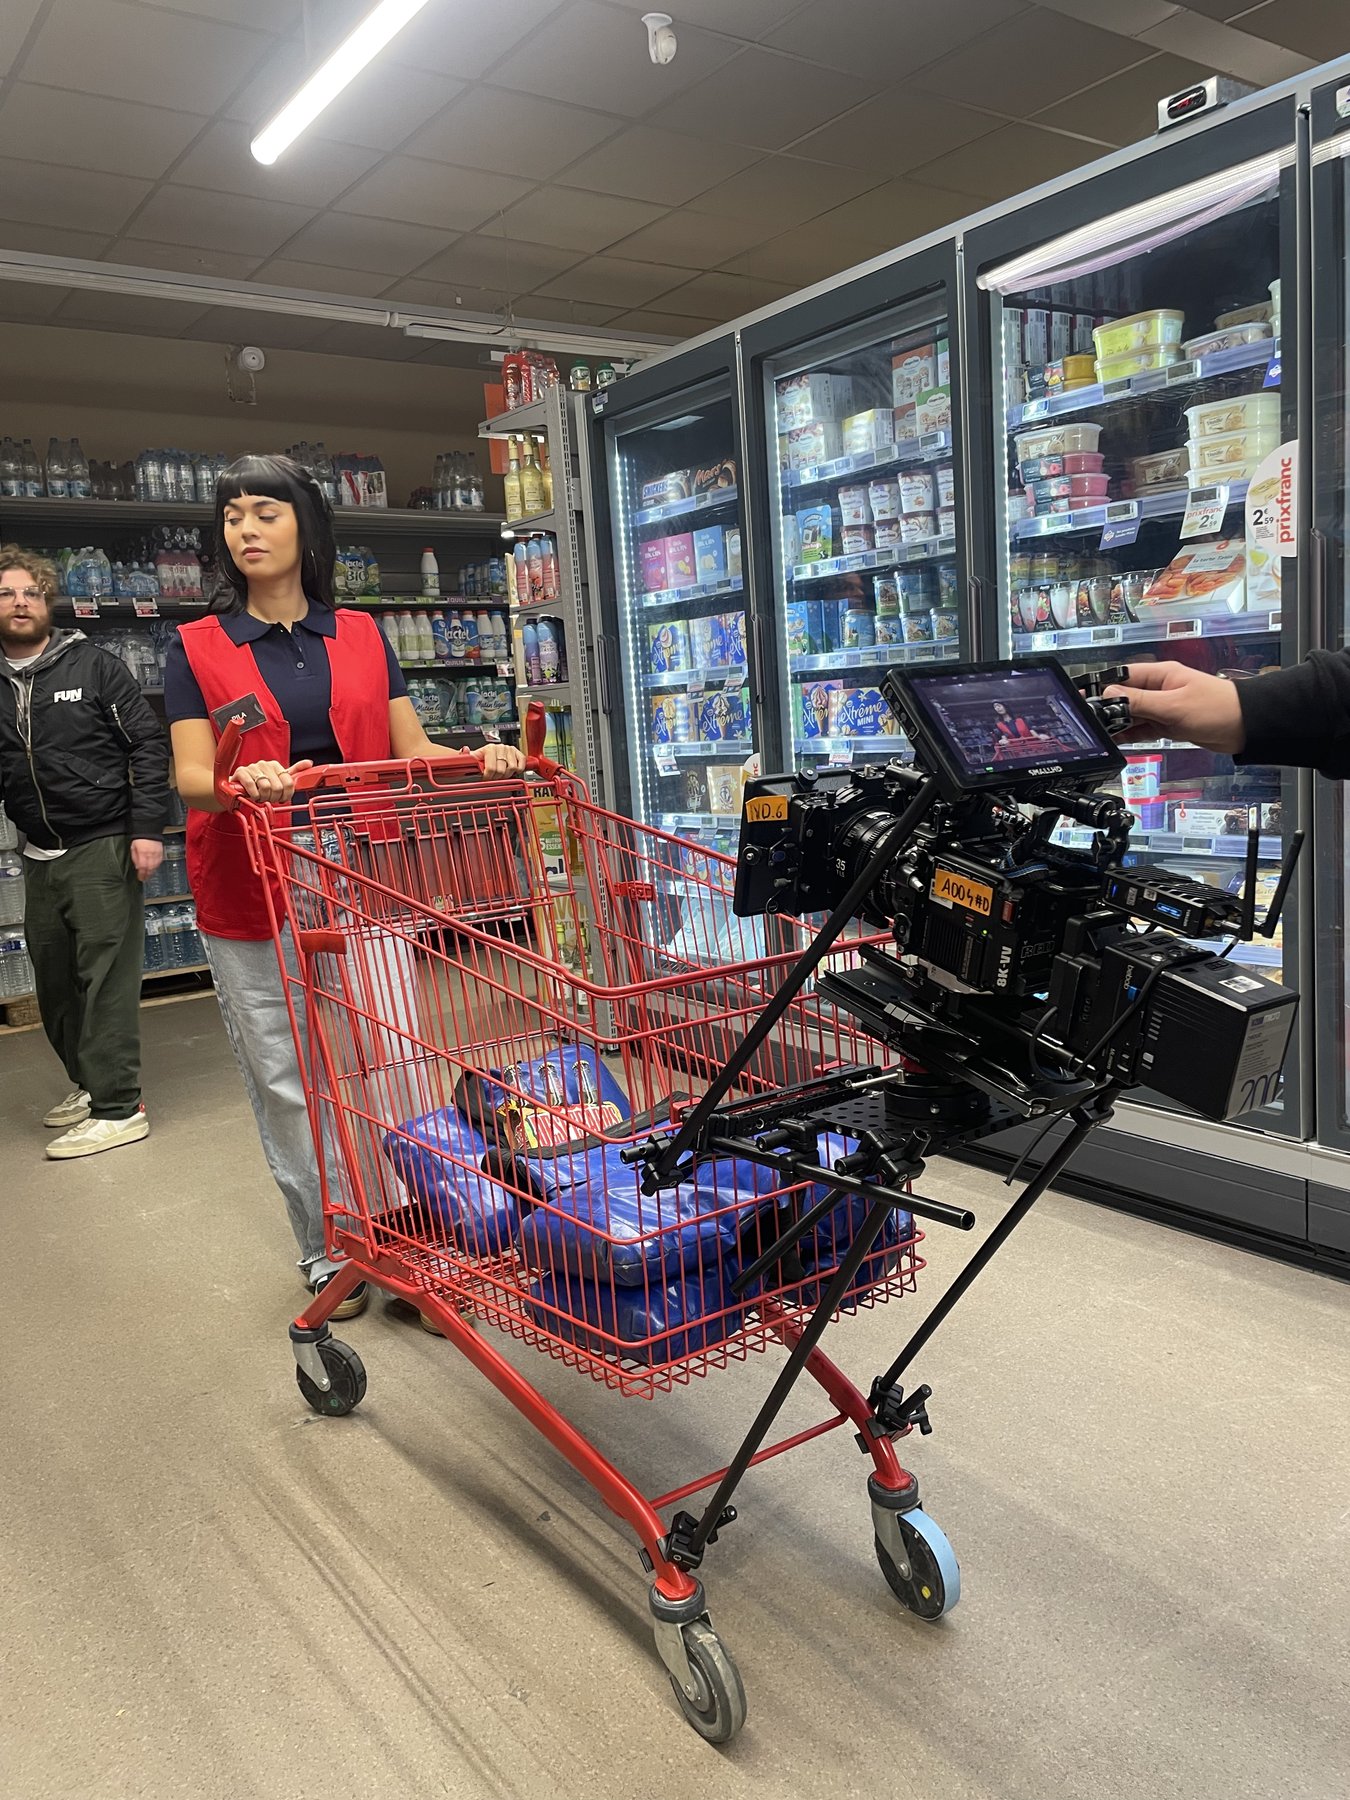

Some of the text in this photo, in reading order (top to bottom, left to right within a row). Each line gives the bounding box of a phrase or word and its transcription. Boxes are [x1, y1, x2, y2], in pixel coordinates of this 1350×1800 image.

[694, 463, 721, 486] Mars
[1275, 457, 1295, 543] prixfranc
[346, 570, 369, 582] BIO
[444, 628, 469, 641] lactel
[53, 687, 83, 703] FUN
[841, 701, 883, 726] extrême
[857, 714, 874, 727] MINI
[1028, 765, 1063, 776] SMALLHD
[835, 858, 846, 871] 35
[996, 945, 1013, 988] 8K-VV
[1123, 964, 1135, 990] bebob
